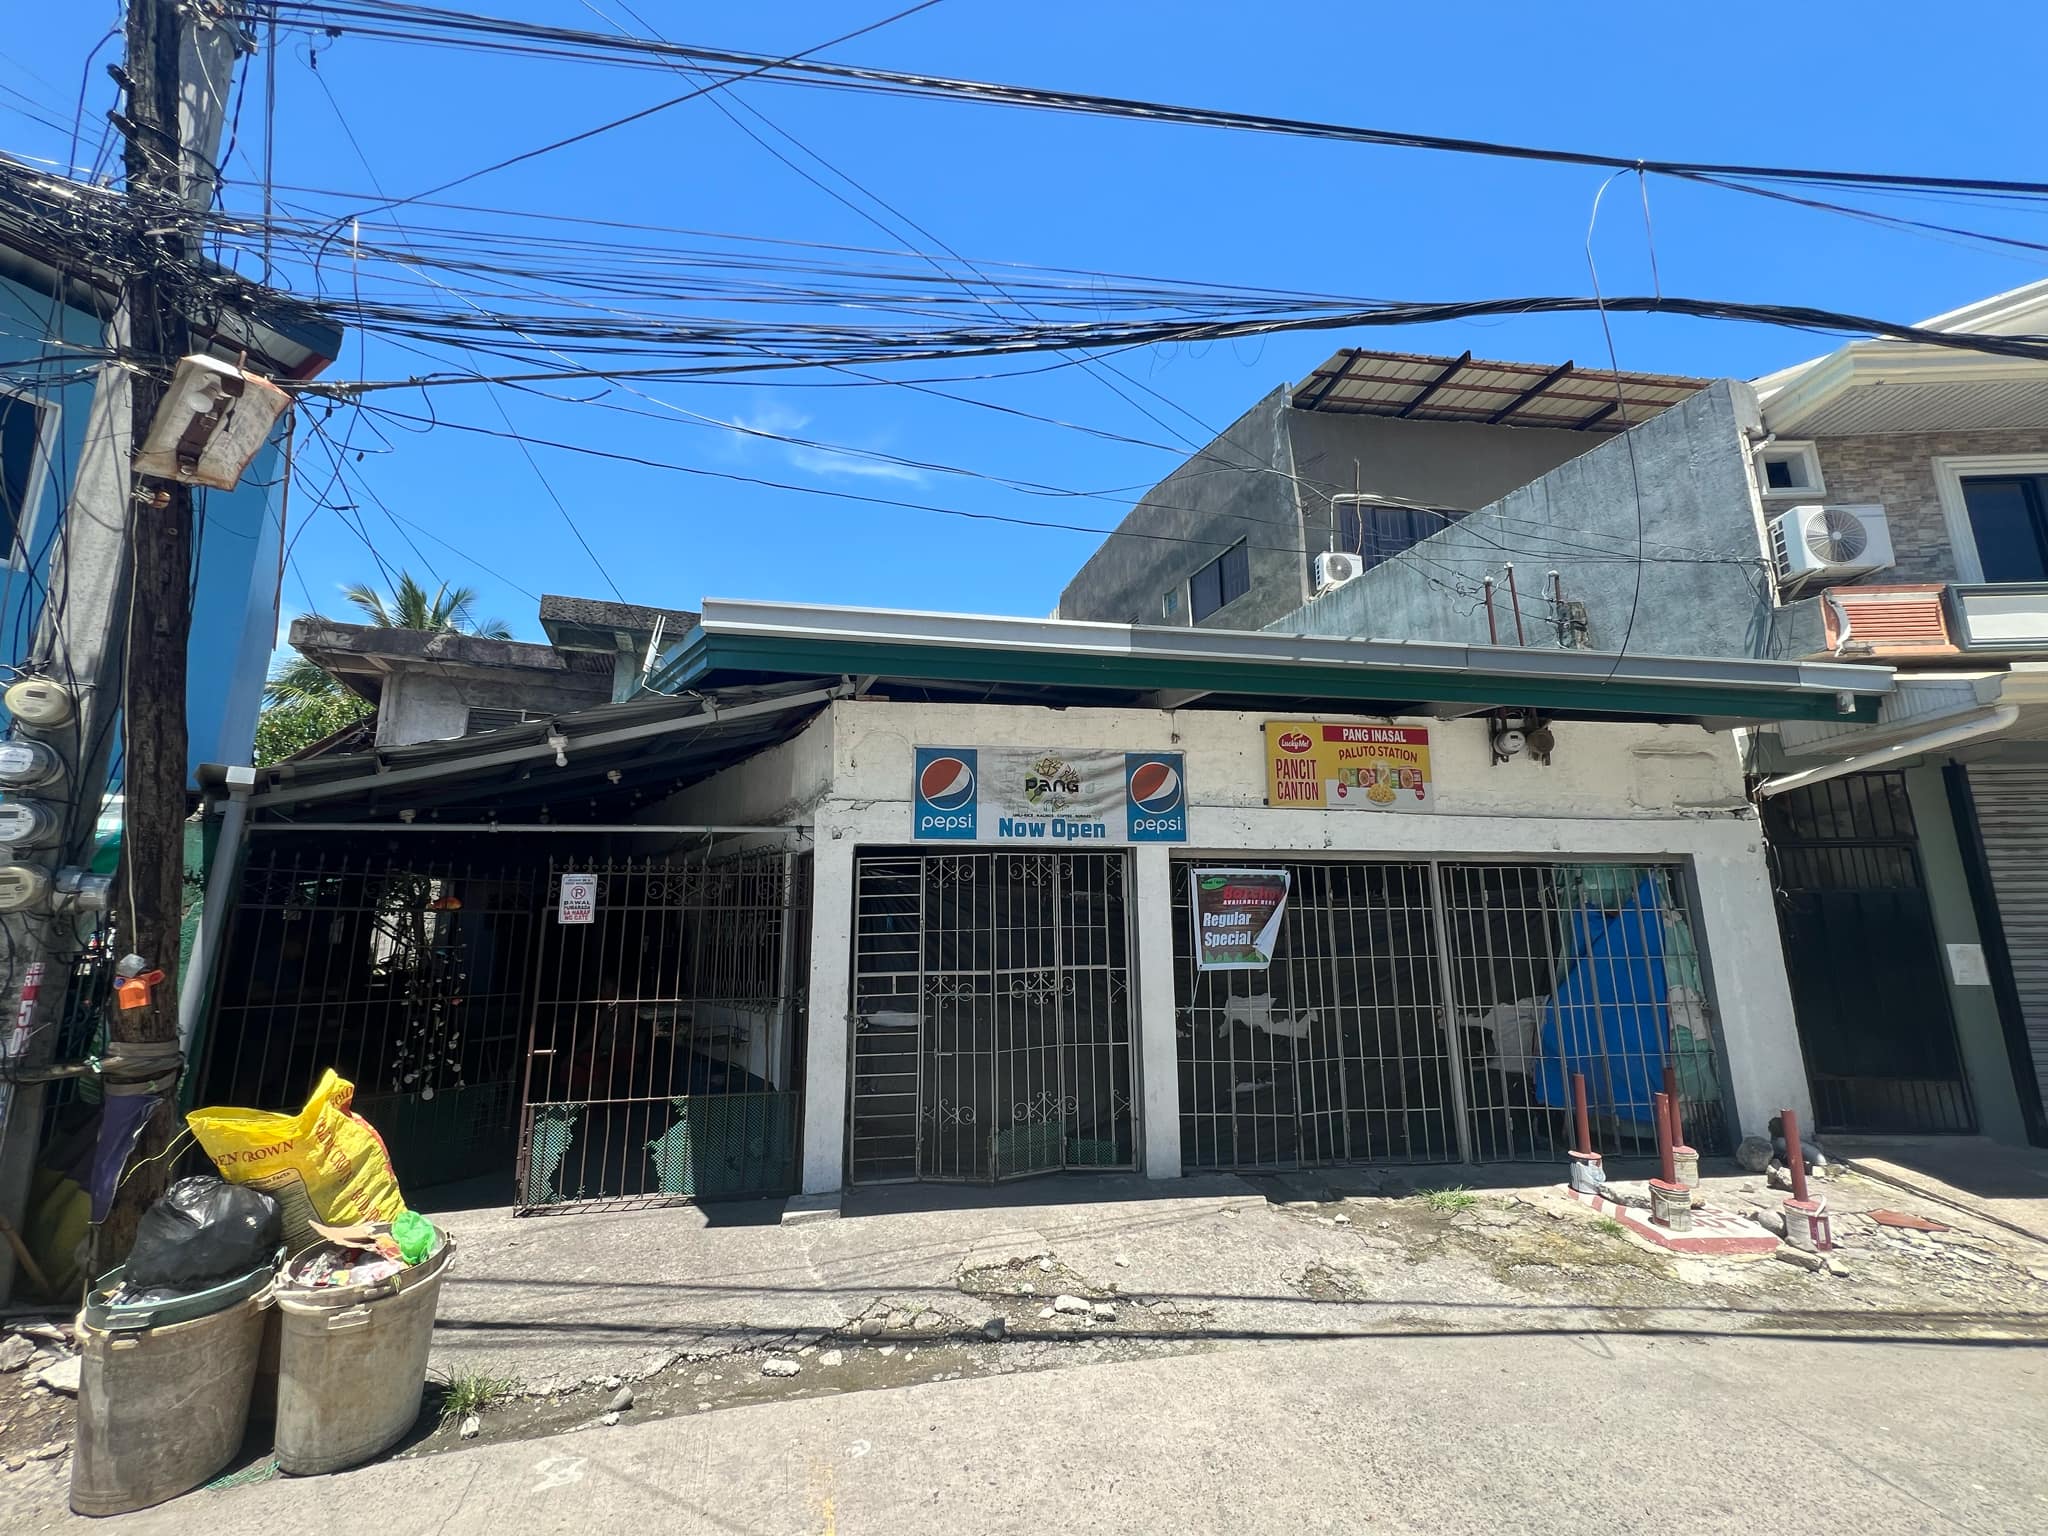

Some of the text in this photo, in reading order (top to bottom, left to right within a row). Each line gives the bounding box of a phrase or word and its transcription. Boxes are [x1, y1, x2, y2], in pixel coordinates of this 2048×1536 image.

[1343, 728, 1407, 743] PANG INASAL
[1338, 746, 1418, 763] PALUTO STATION
[1276, 759, 1317, 781] PANCIT
[1277, 781, 1319, 801] CANTON
[921, 814, 973, 833] pepsi
[999, 817, 1106, 841] Now Open
[1134, 816, 1182, 834] pepsi
[1203, 911, 1252, 928] Regular
[1204, 930, 1251, 948] Special
